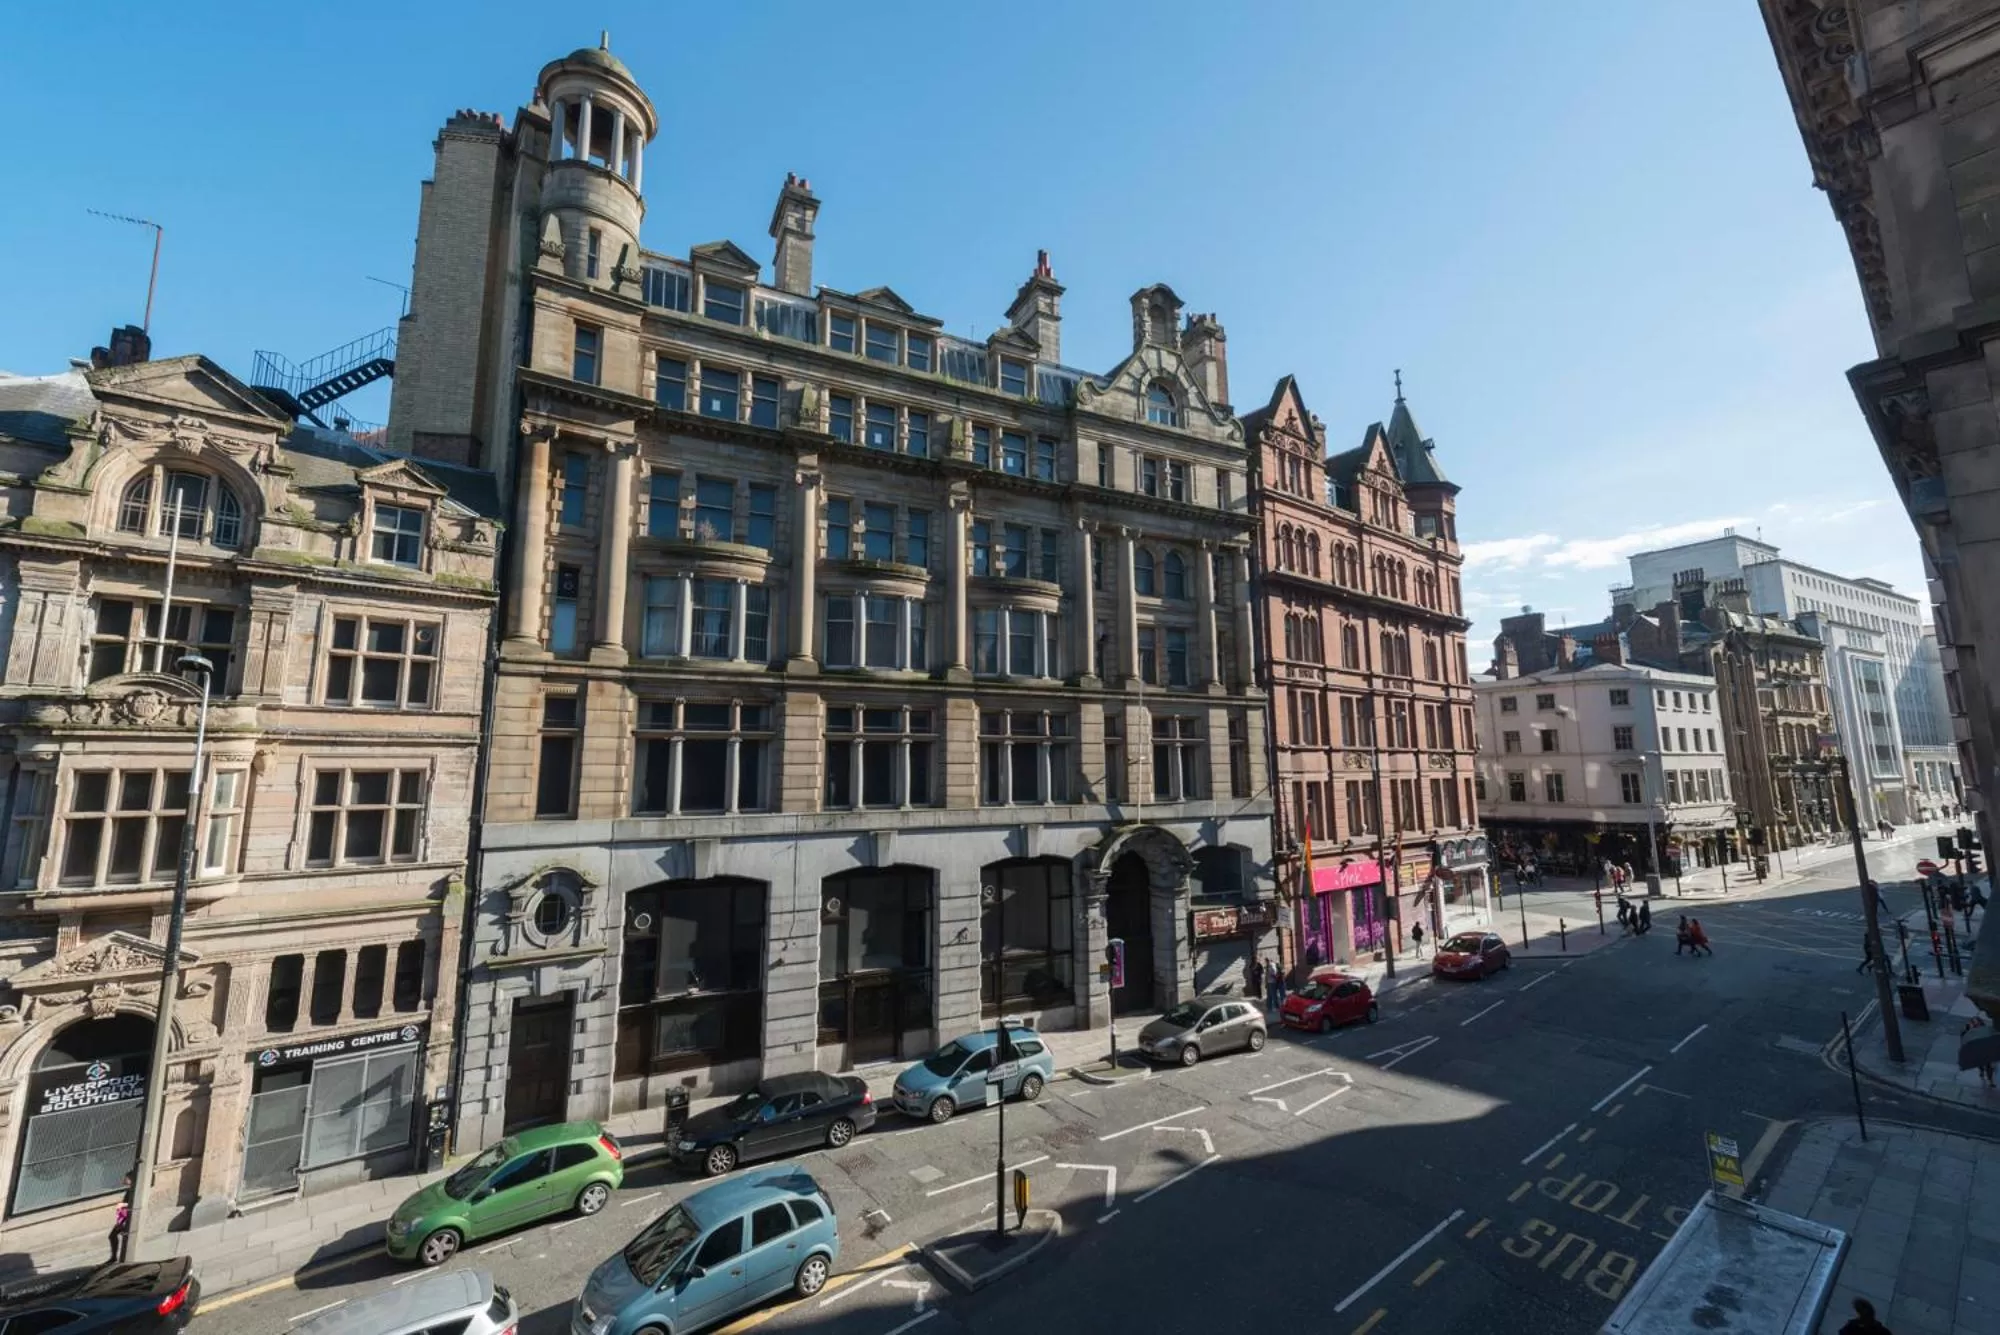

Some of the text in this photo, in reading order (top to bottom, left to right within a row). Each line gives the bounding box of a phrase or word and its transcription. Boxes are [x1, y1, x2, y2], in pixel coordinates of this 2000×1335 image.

[284, 1031, 398, 1059] TRAINING CENTRE
[44, 1074, 144, 1098] LIVERPOOL
[49, 1082, 138, 1104] SECURITY
[40, 1087, 144, 1114] SOLUTIONS
[1501, 1217, 1638, 1300] BUS
